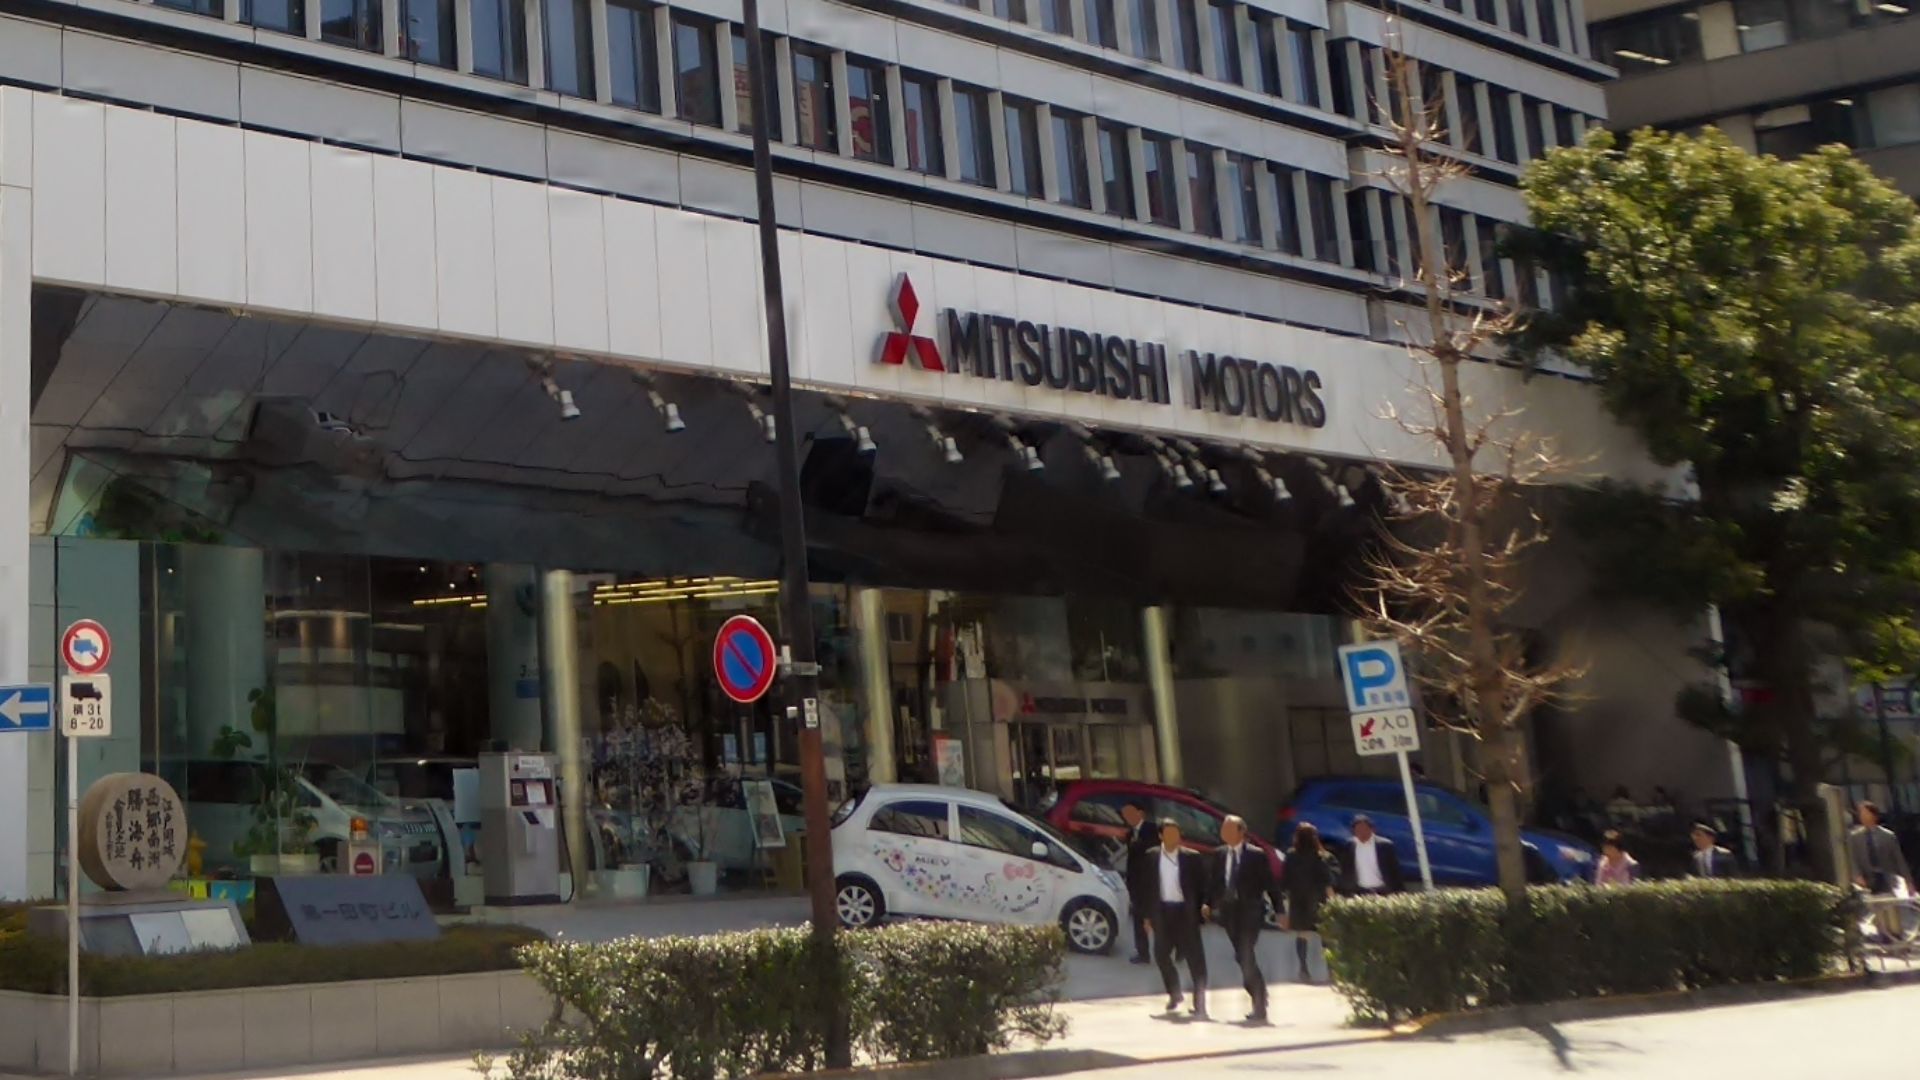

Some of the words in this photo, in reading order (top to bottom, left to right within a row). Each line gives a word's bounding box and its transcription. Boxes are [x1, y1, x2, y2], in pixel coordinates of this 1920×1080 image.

[937, 307, 1171, 404] MITSUBISHI
[1179, 349, 1326, 428] MOTORS
[1346, 648, 1396, 706] P
